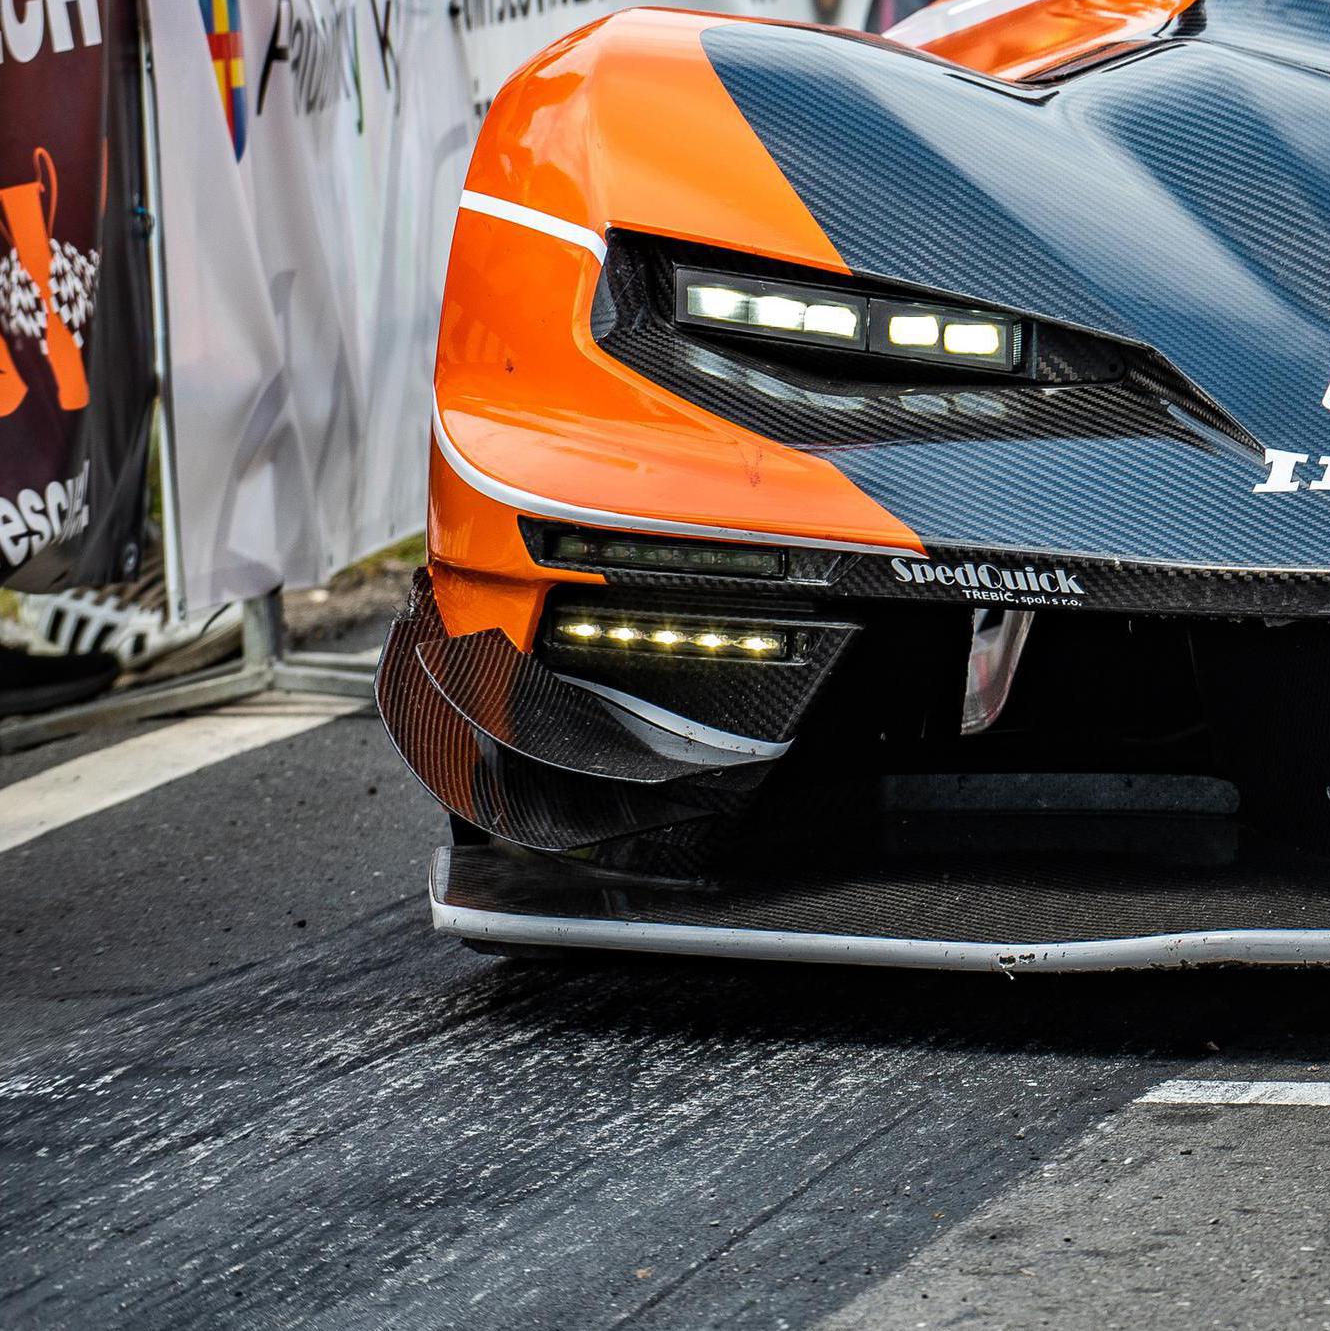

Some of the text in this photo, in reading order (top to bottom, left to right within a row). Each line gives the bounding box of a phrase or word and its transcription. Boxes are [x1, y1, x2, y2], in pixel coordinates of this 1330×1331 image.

[890, 557, 1086, 594] SpedQuick
[1021, 596, 1050, 606] spol.
[1062, 599, 1082, 607] r.o.
